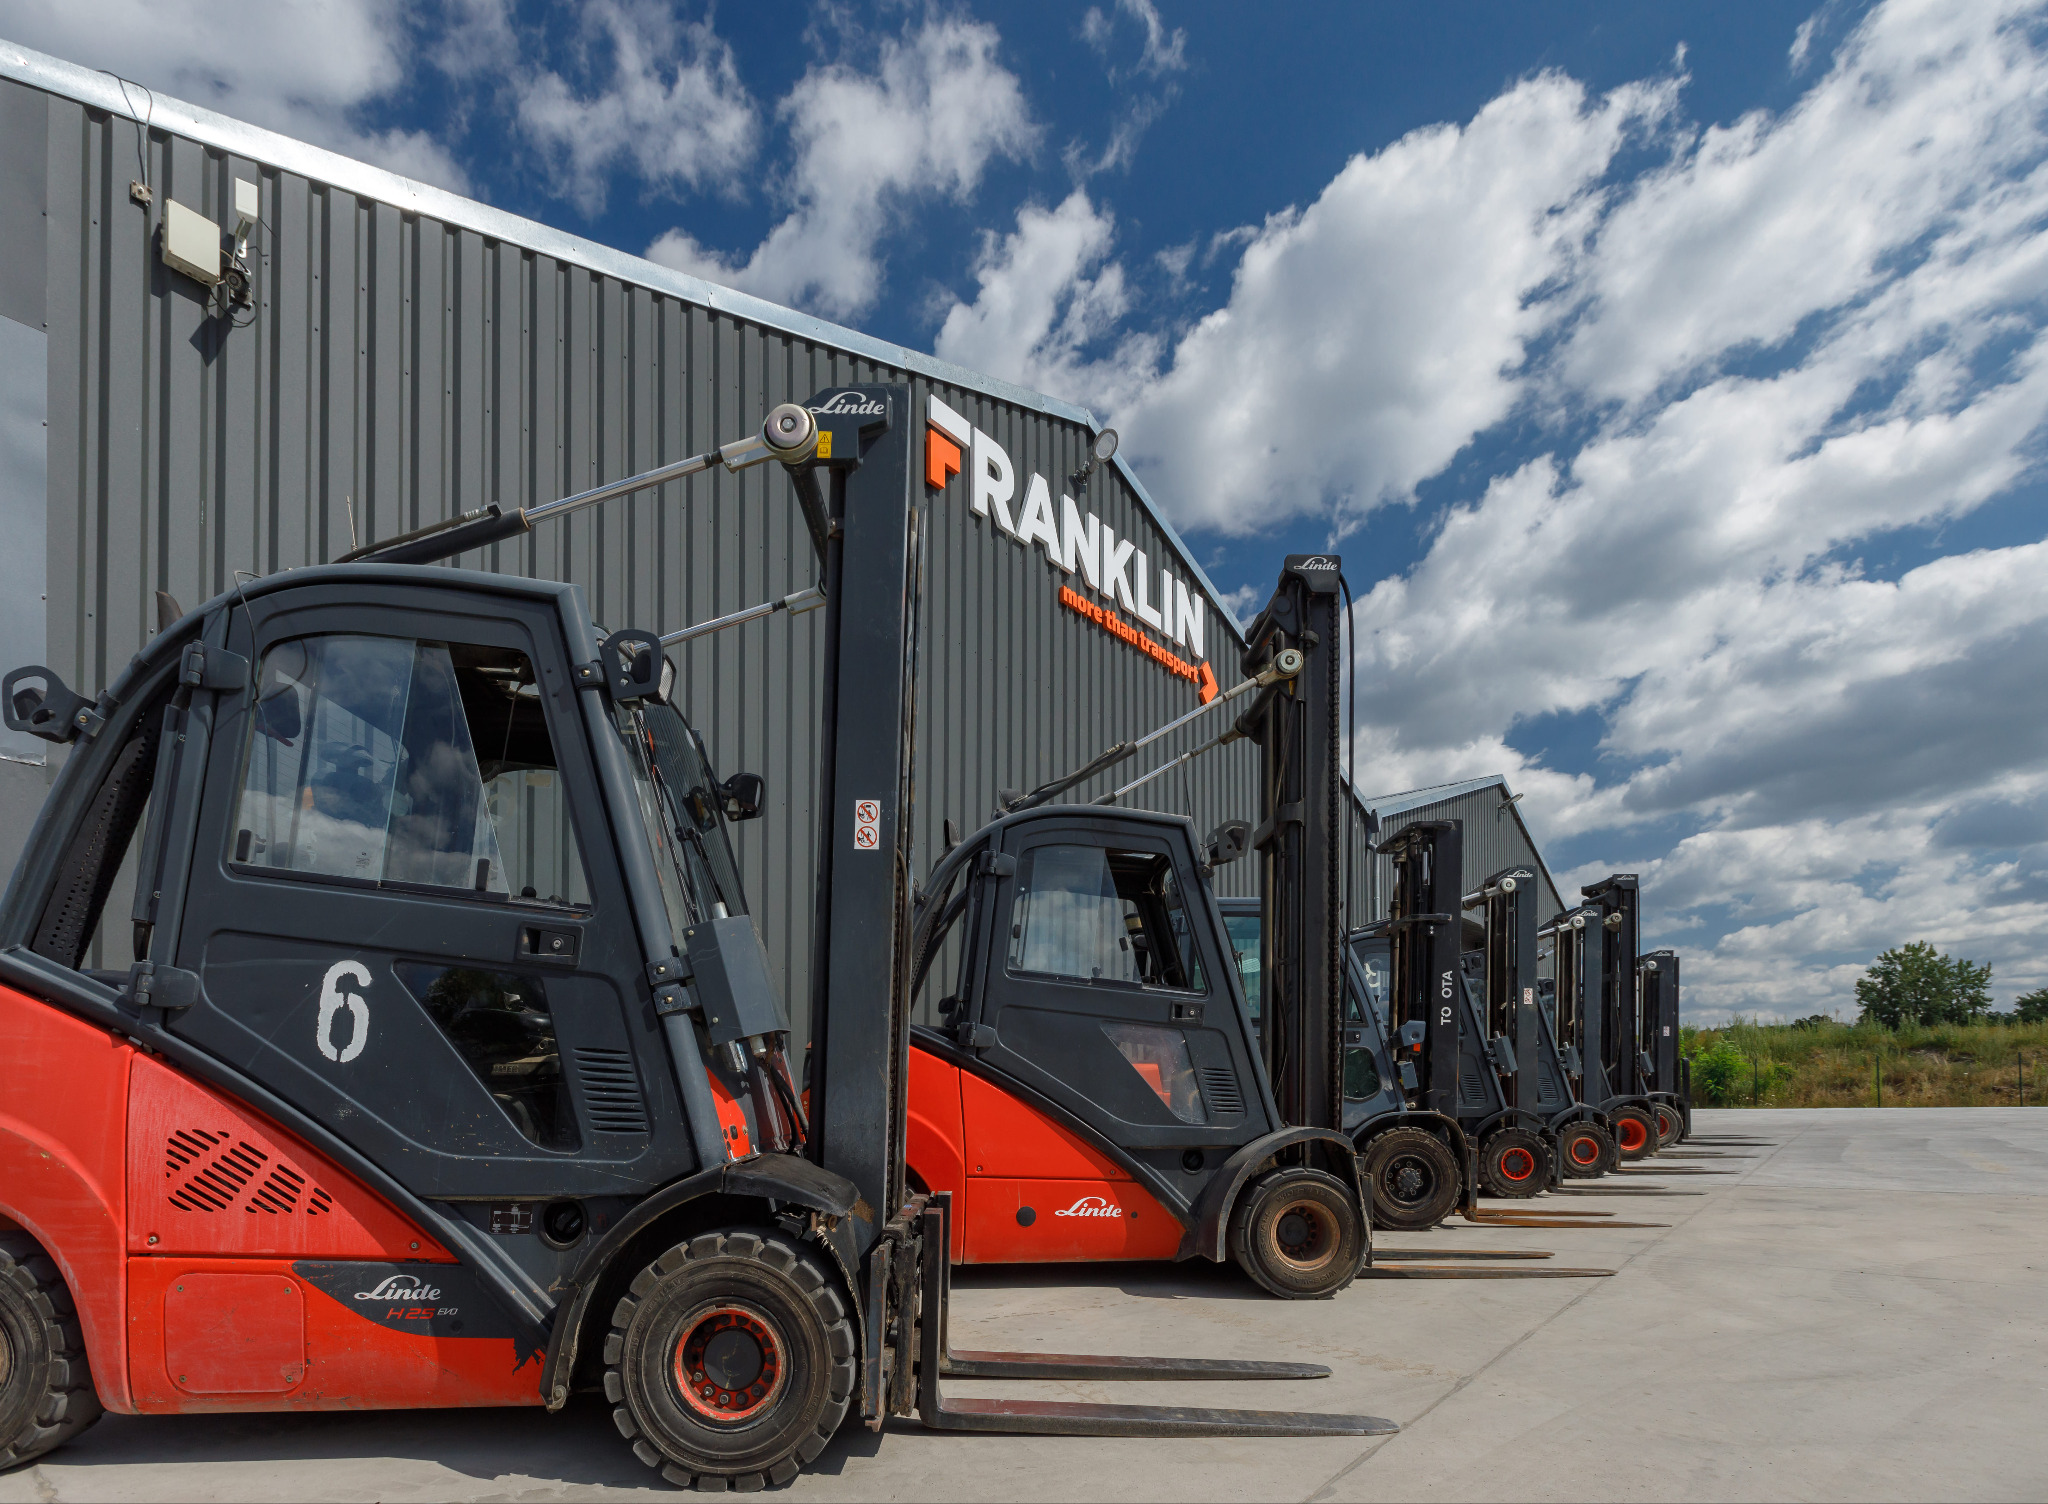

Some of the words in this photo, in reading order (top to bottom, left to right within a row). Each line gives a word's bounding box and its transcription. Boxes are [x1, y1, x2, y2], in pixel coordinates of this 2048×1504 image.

[807, 391, 885, 415] Linde
[926, 394, 1204, 659] FRANKLIN
[1294, 556, 1338, 571] Linde
[1059, 585, 1103, 624] more
[1102, 609, 1138, 645] than
[1137, 630, 1199, 684] transport
[1508, 869, 1533, 877] Linde
[316, 959, 373, 1063] 6
[1054, 1196, 1122, 1218] Linde
[354, 1274, 441, 1301] Linde
[437, 1307, 459, 1316] EVO
